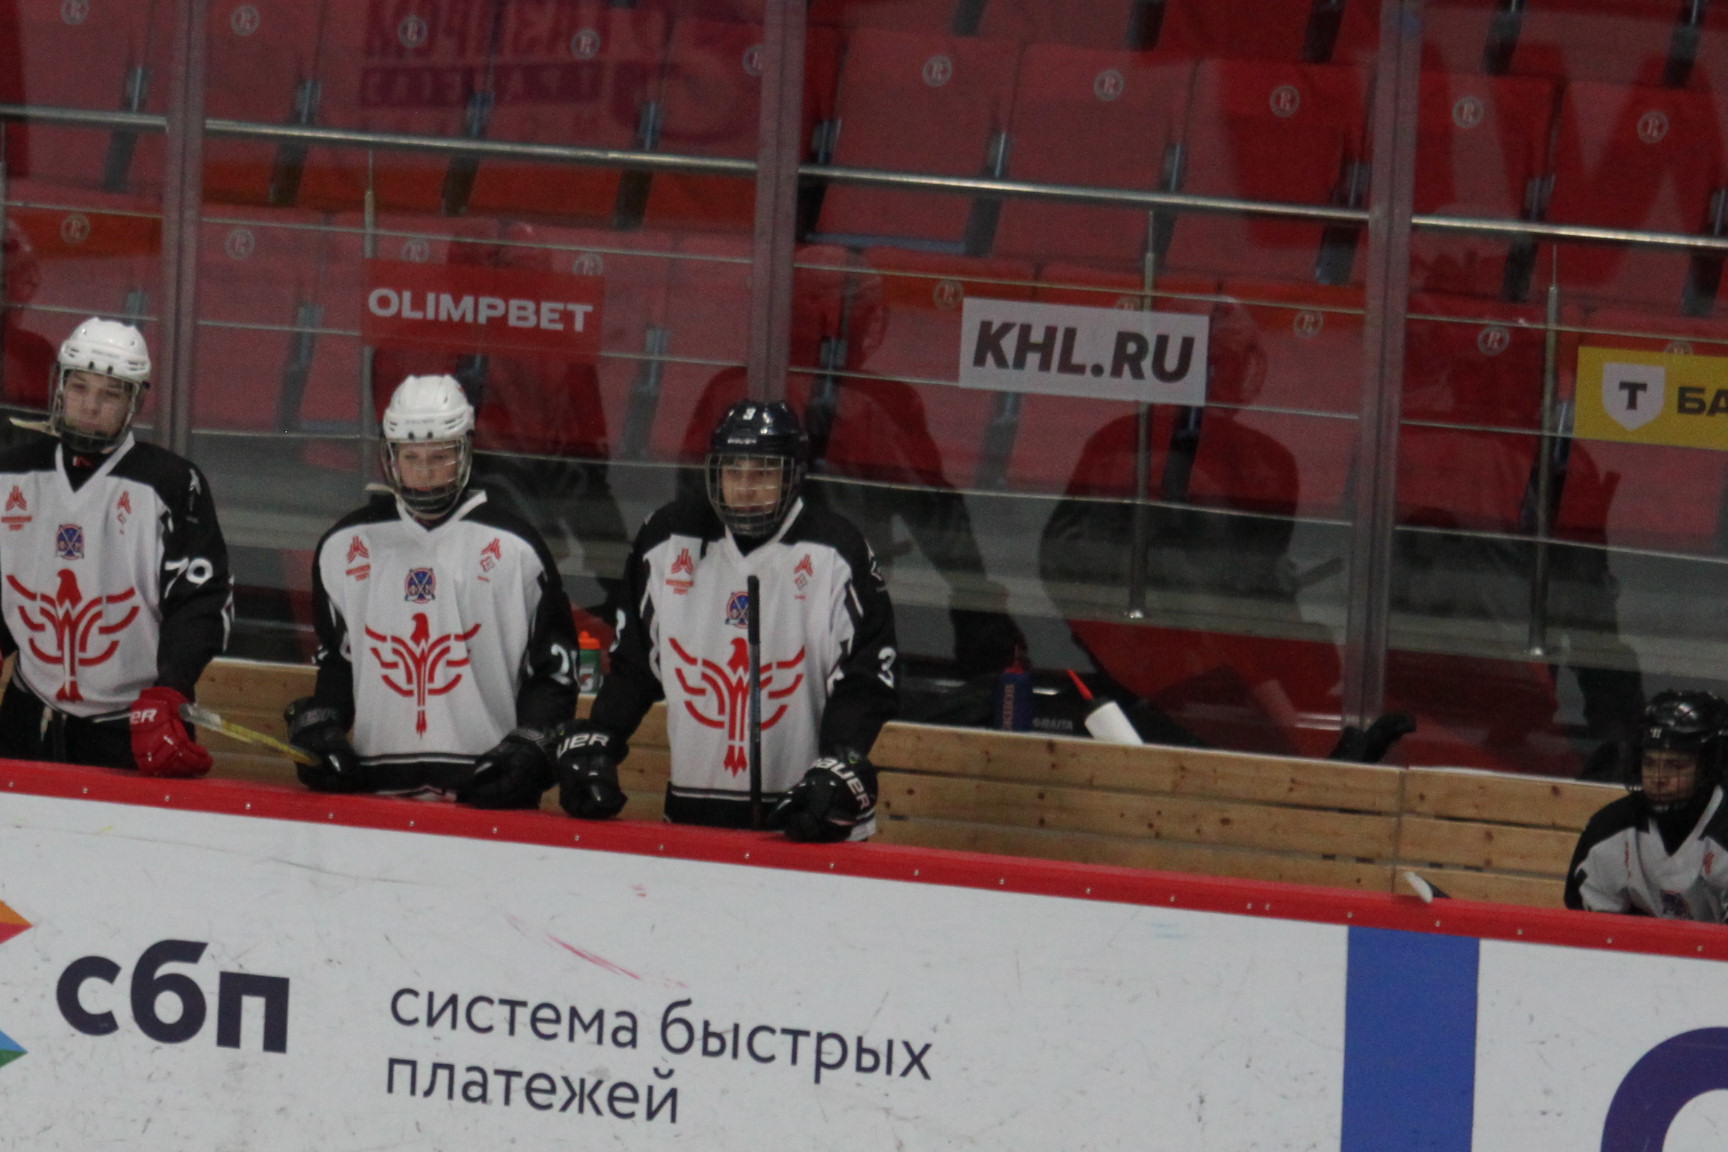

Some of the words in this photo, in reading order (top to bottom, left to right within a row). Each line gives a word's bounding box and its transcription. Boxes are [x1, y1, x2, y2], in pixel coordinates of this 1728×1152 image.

[367, 286, 595, 335] OLIMPBET
[972, 319, 1195, 385] KHL.RU
[56, 938, 290, 1054] сбп
[390, 987, 638, 1049] система
[660, 998, 933, 1085] быстрых
[386, 1057, 679, 1124] платежей
